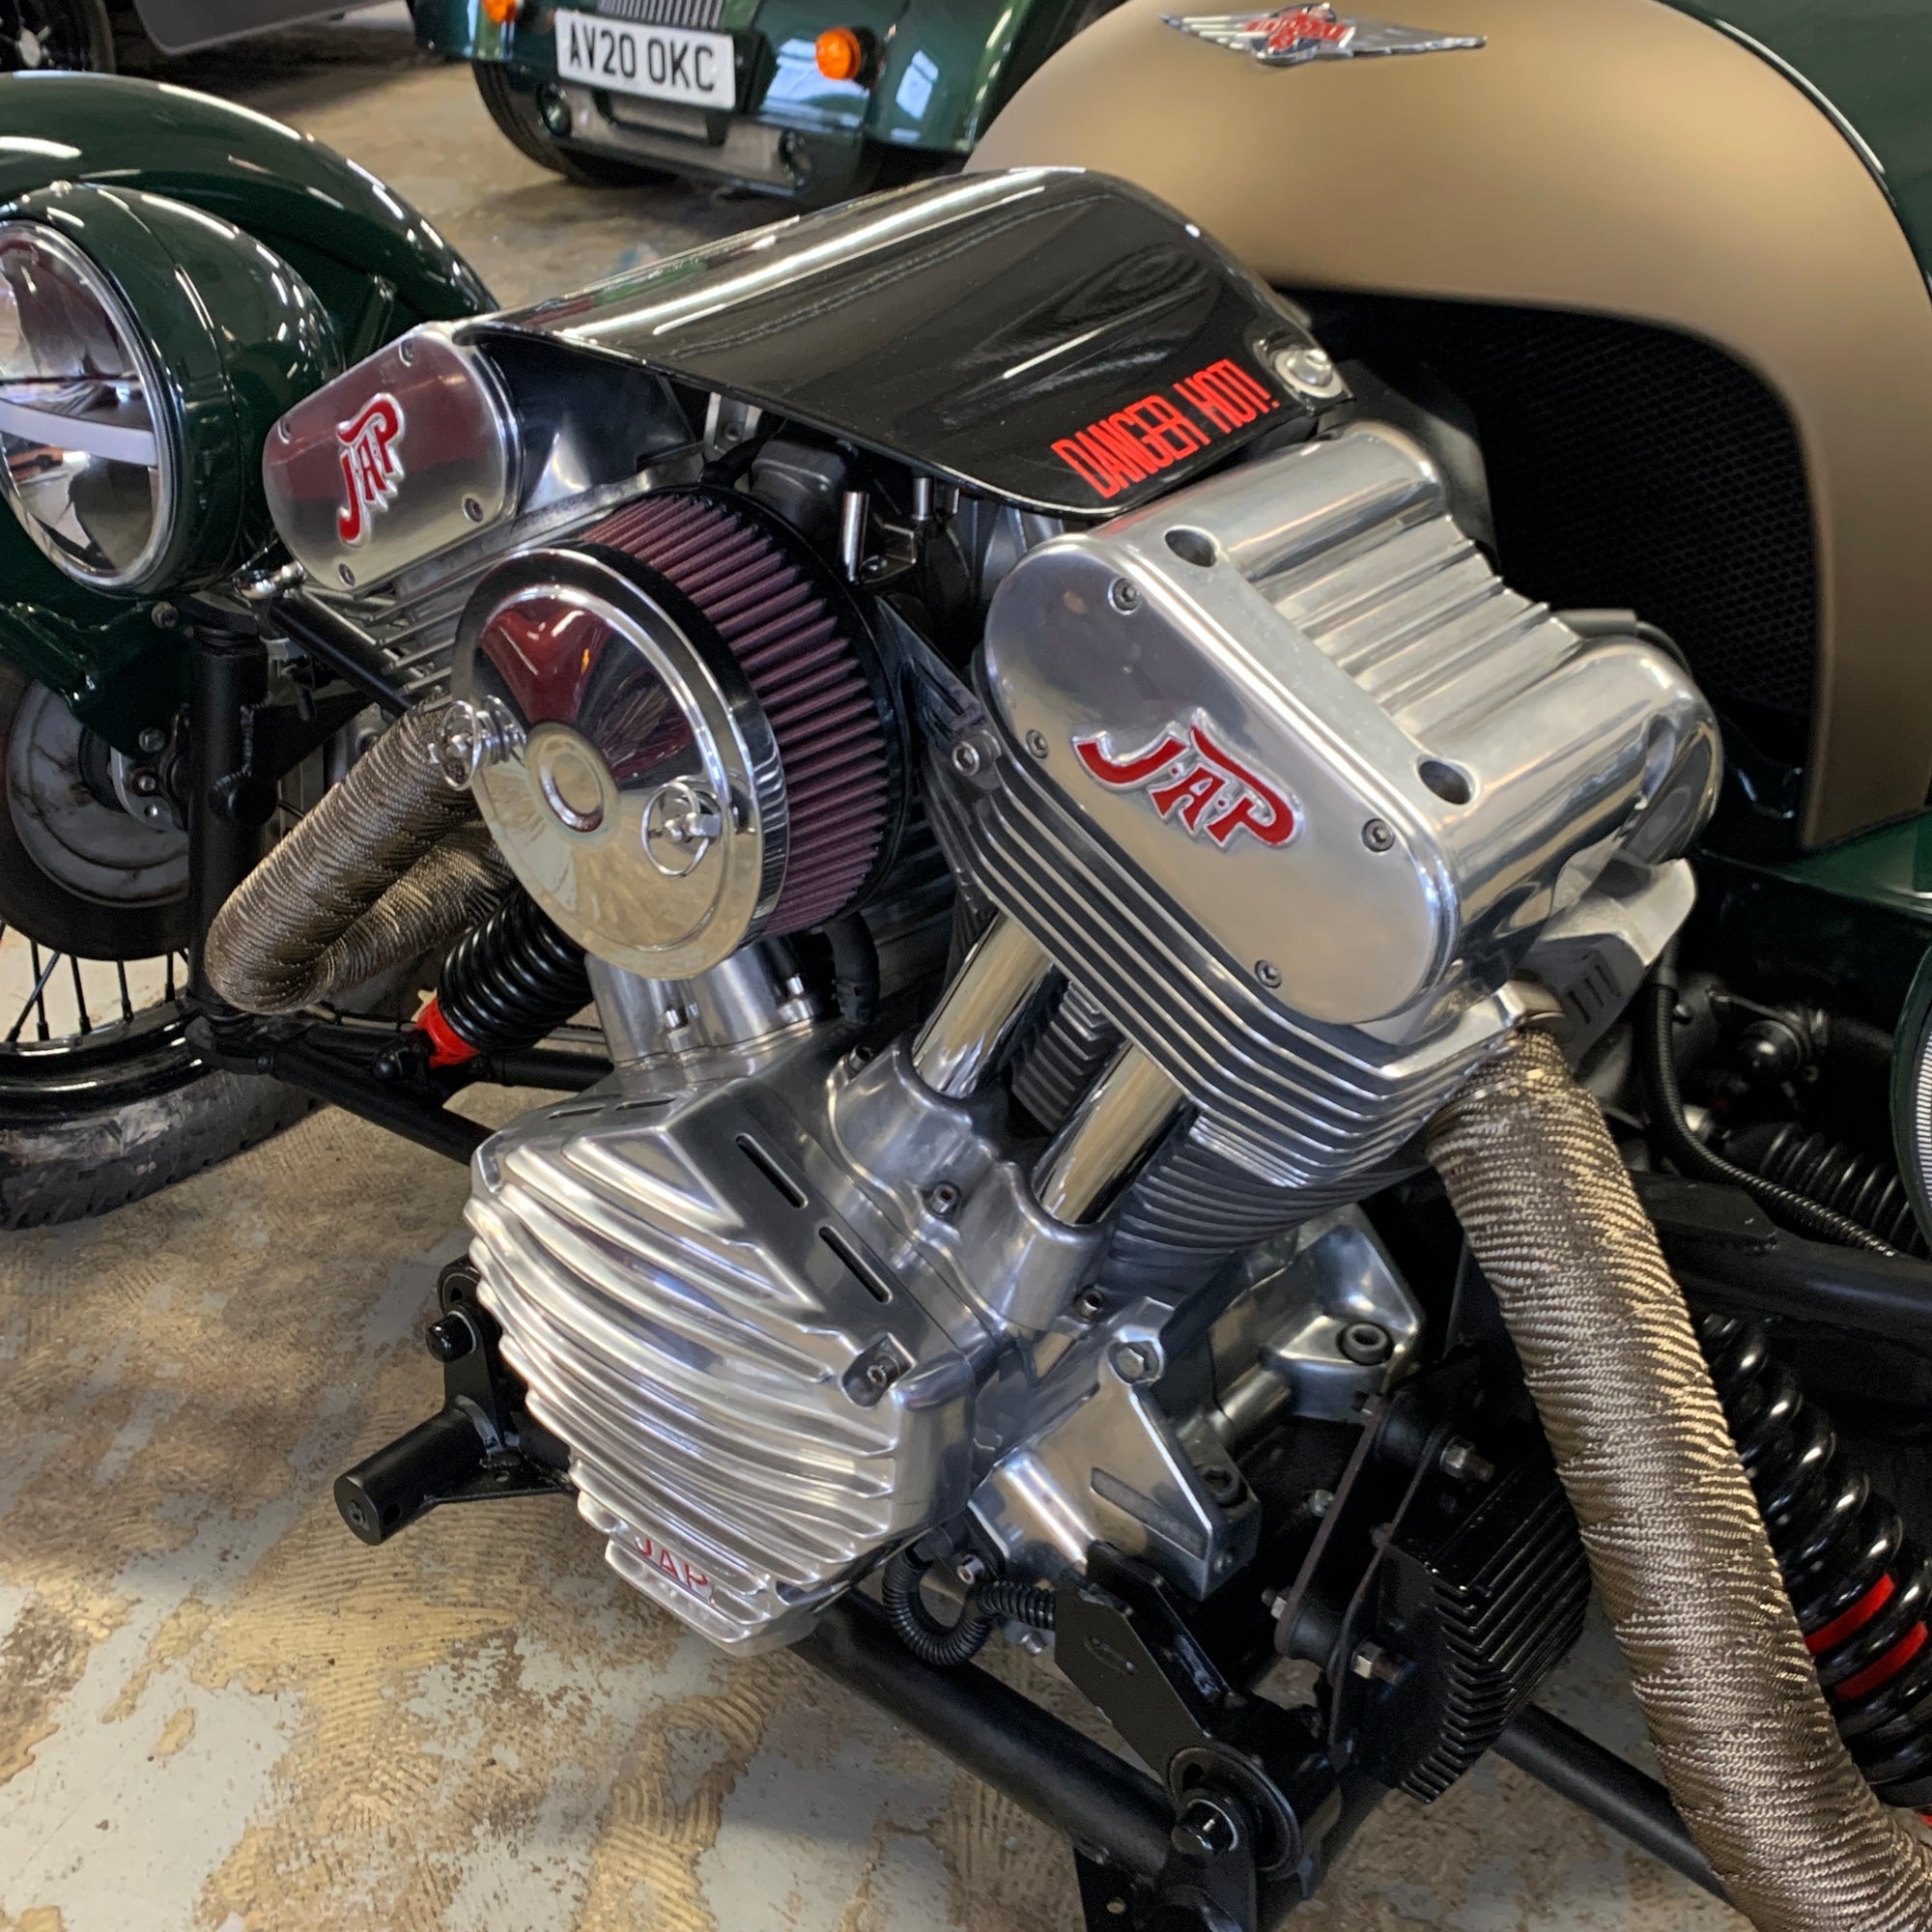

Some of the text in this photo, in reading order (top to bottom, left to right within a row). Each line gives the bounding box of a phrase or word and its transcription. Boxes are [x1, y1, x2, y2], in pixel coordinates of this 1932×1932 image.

[569, 21, 715, 93] AV20 OKC
[1050, 358, 1281, 499] DANGER HOT!
